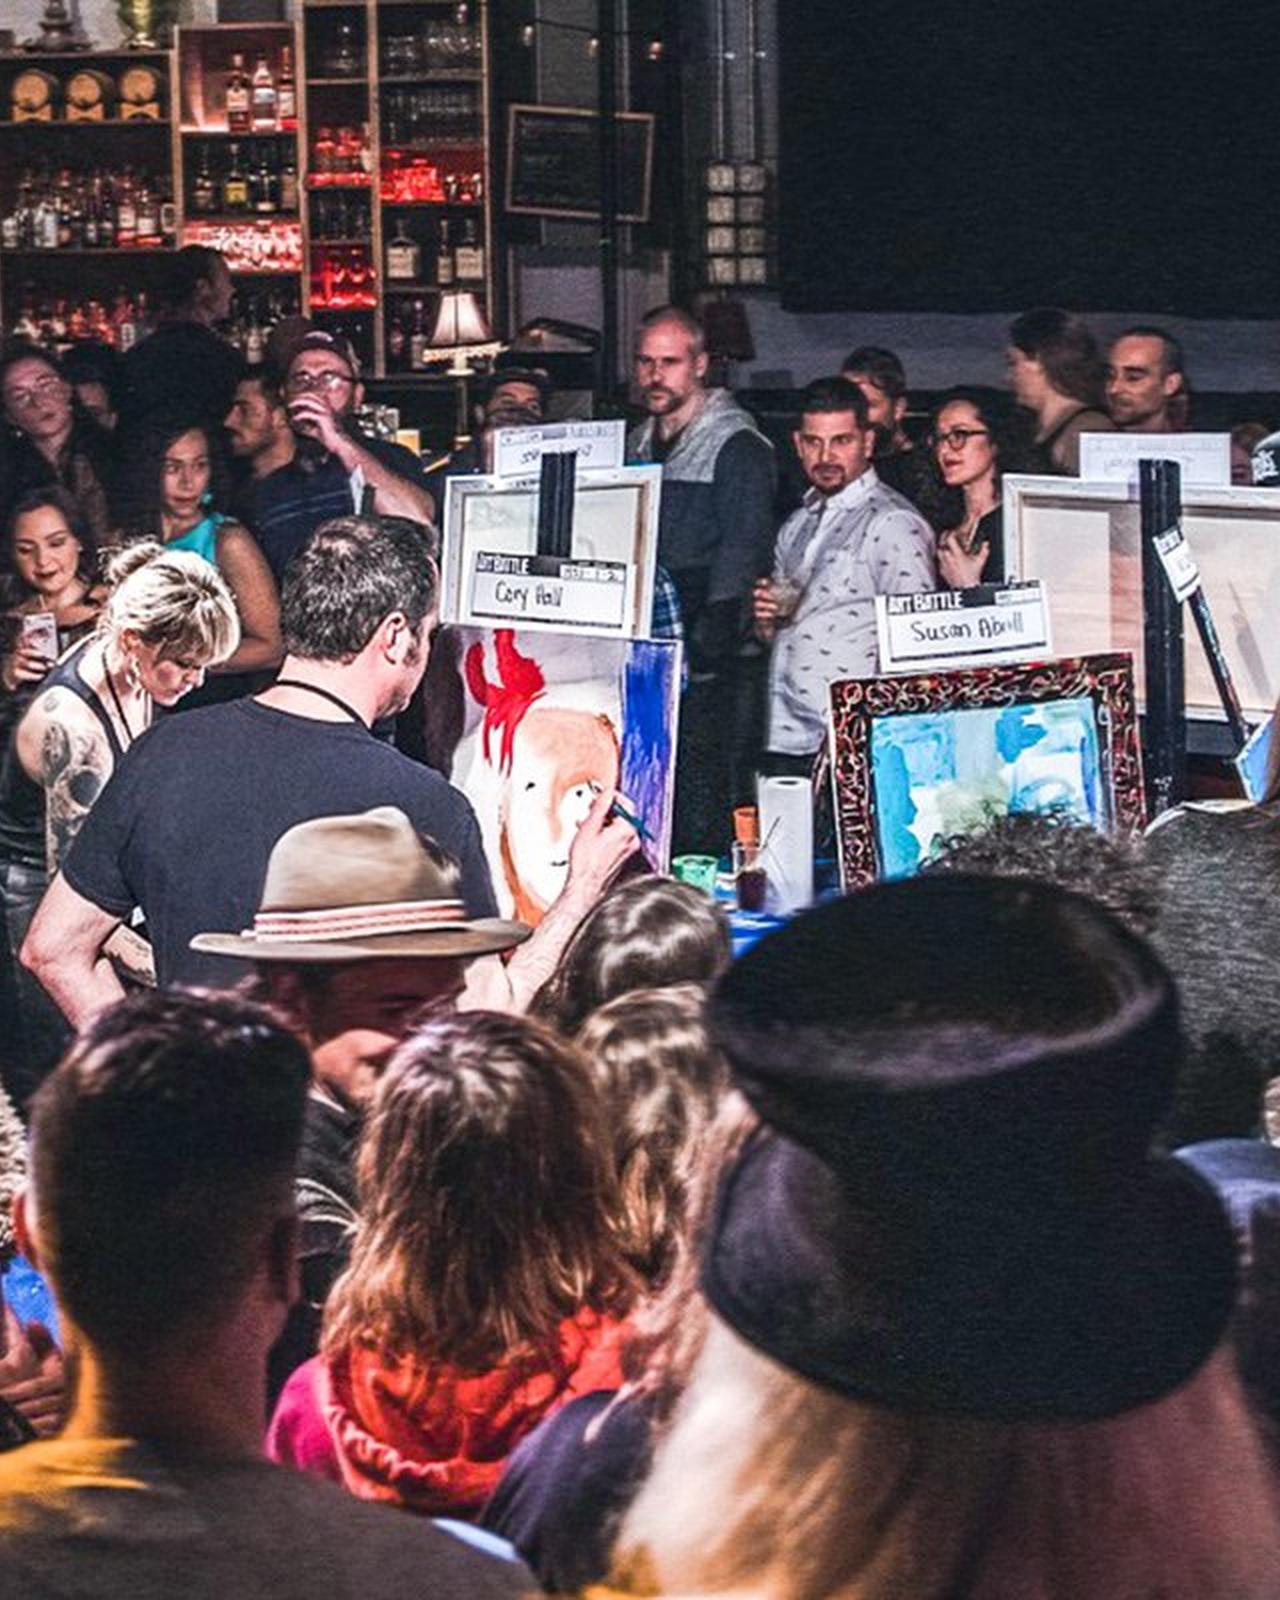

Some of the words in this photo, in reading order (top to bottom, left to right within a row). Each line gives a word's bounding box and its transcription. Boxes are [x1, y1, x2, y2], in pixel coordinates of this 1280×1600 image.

[495, 580, 529, 611] Cory
[914, 591, 963, 613] BATTLE
[910, 620, 971, 642] Susan
